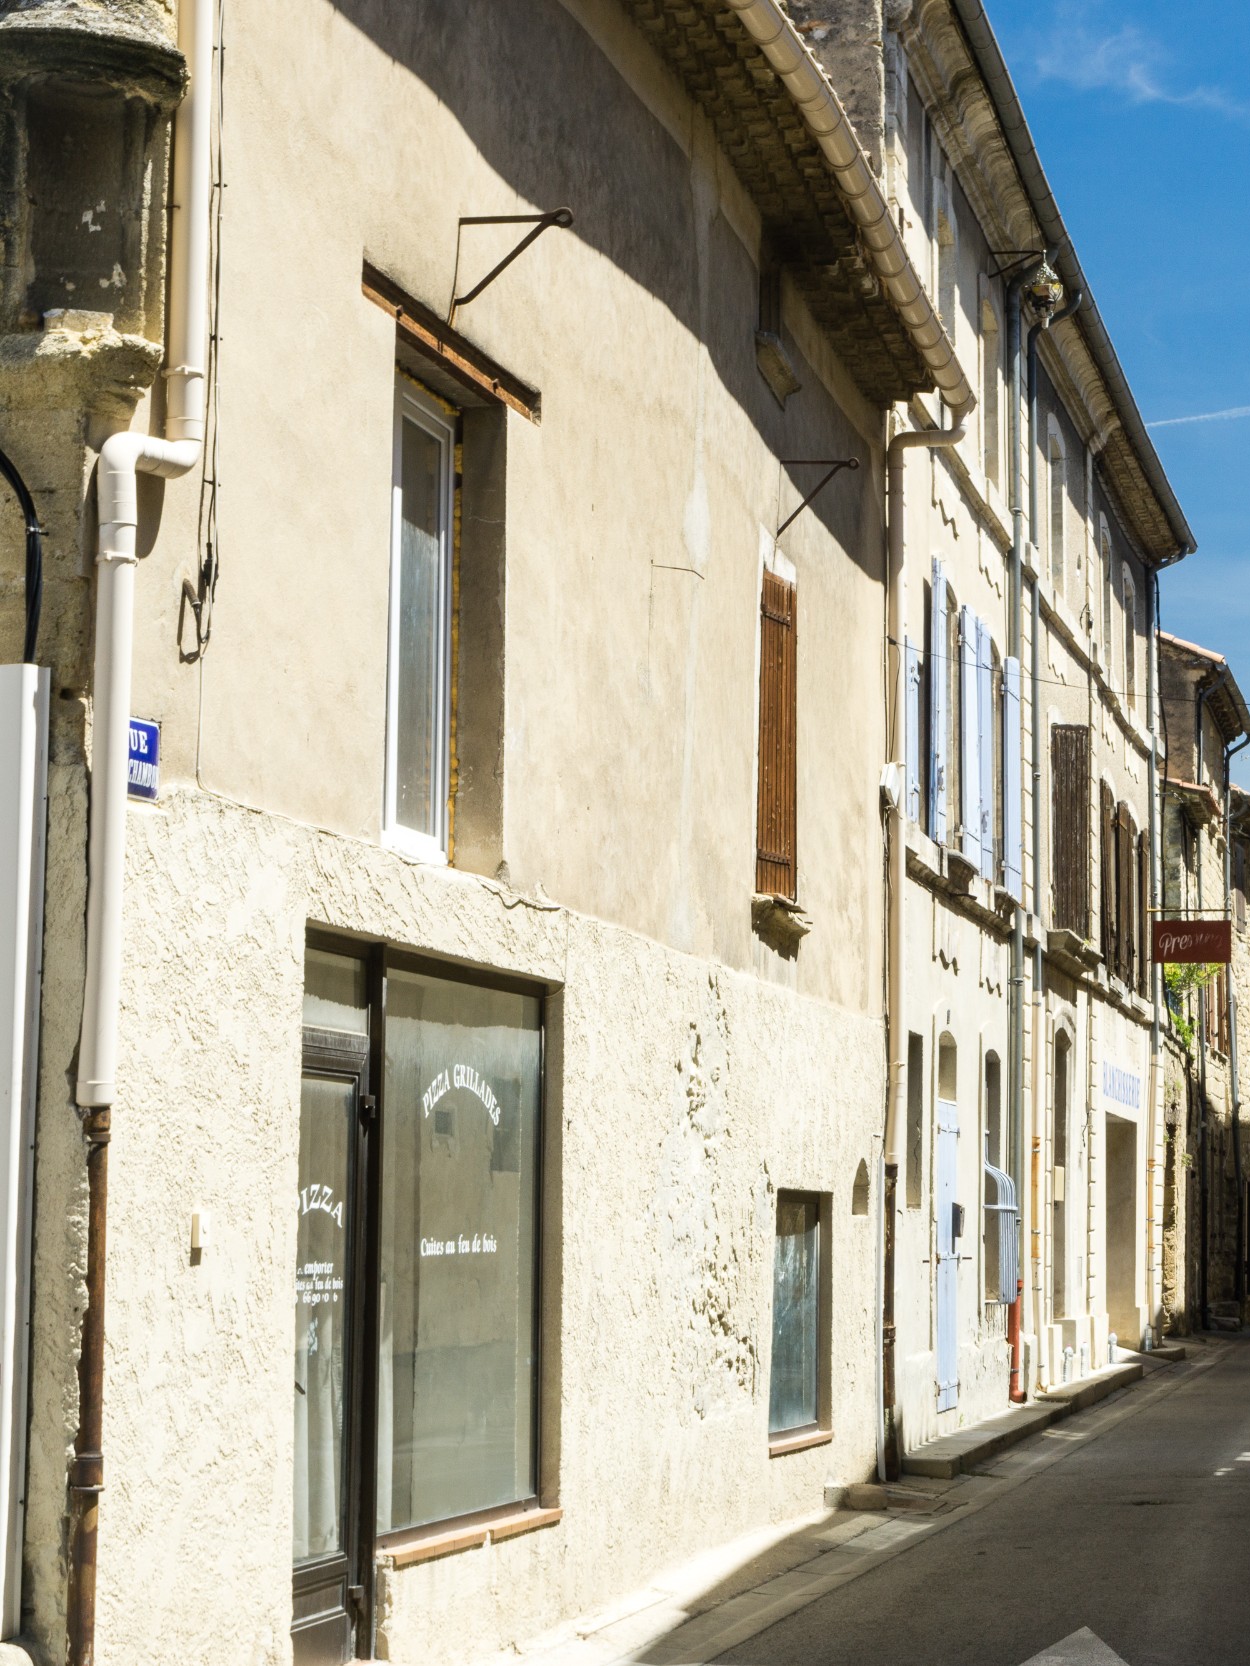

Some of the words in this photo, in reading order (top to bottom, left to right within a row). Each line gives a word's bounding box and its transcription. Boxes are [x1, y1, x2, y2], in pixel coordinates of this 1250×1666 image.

[129, 728, 149, 754] UE
[422, 1068, 451, 1119] PIZZA
[453, 1063, 501, 1126] GRILLADES
[1103, 1060, 1141, 1109] BLANCHISSERIE
[420, 1237, 444, 1256] Cuites
[445, 1240, 456, 1254] au
[458, 1233, 470, 1254] feu
[471, 1233, 481, 1253] de
[482, 1233, 497, 1253] bois
[304, 1261, 334, 1281] emporter
